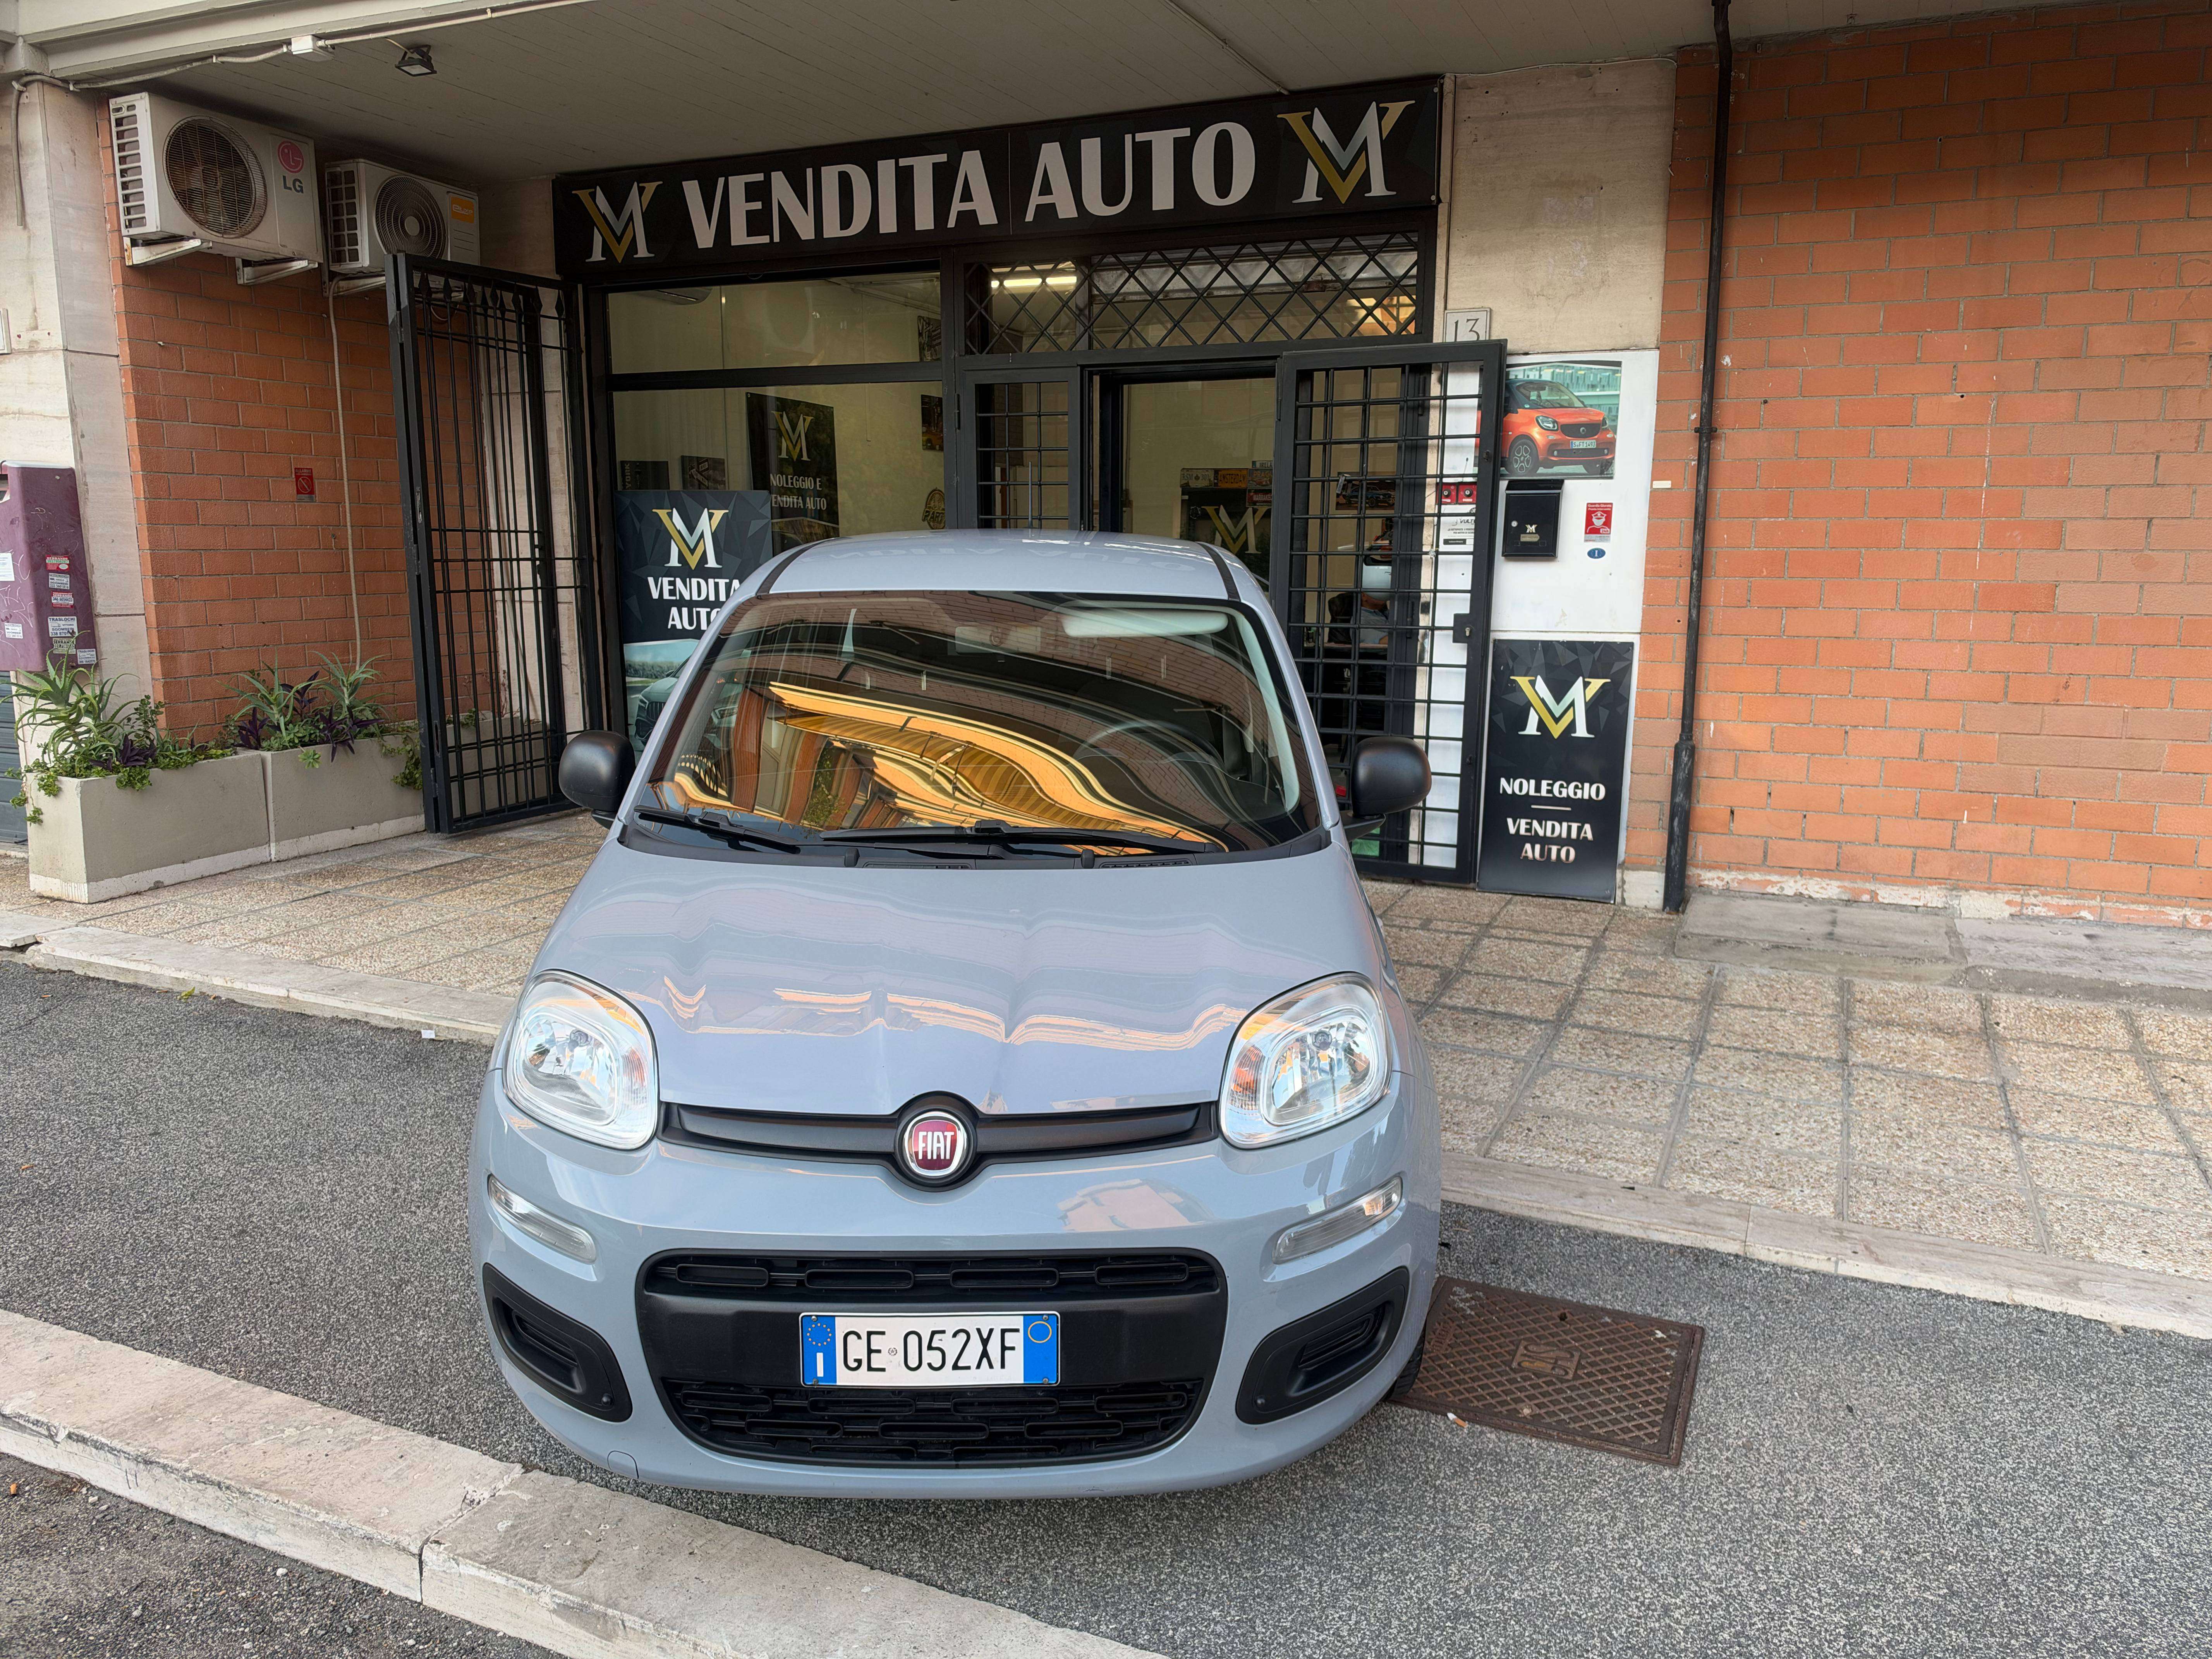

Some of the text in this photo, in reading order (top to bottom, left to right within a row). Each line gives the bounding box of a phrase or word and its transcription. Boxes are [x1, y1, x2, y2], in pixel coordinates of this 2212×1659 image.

[282, 175, 304, 194] LG
[682, 122, 1255, 249] VENDITA AUTO
[1454, 318, 1480, 342] 13
[770, 474, 822, 490] NOLEGGIO E
[771, 494, 827, 510] ENDITA AUTO
[1499, 778, 1606, 801] NOLEGGIO
[1506, 818, 1593, 841] VENDITA
[1520, 843, 1575, 864] AUTO
[918, 1131, 954, 1160] FIAT
[843, 1328, 1020, 1372] GE 052XF
[816, 1352, 824, 1377] I
